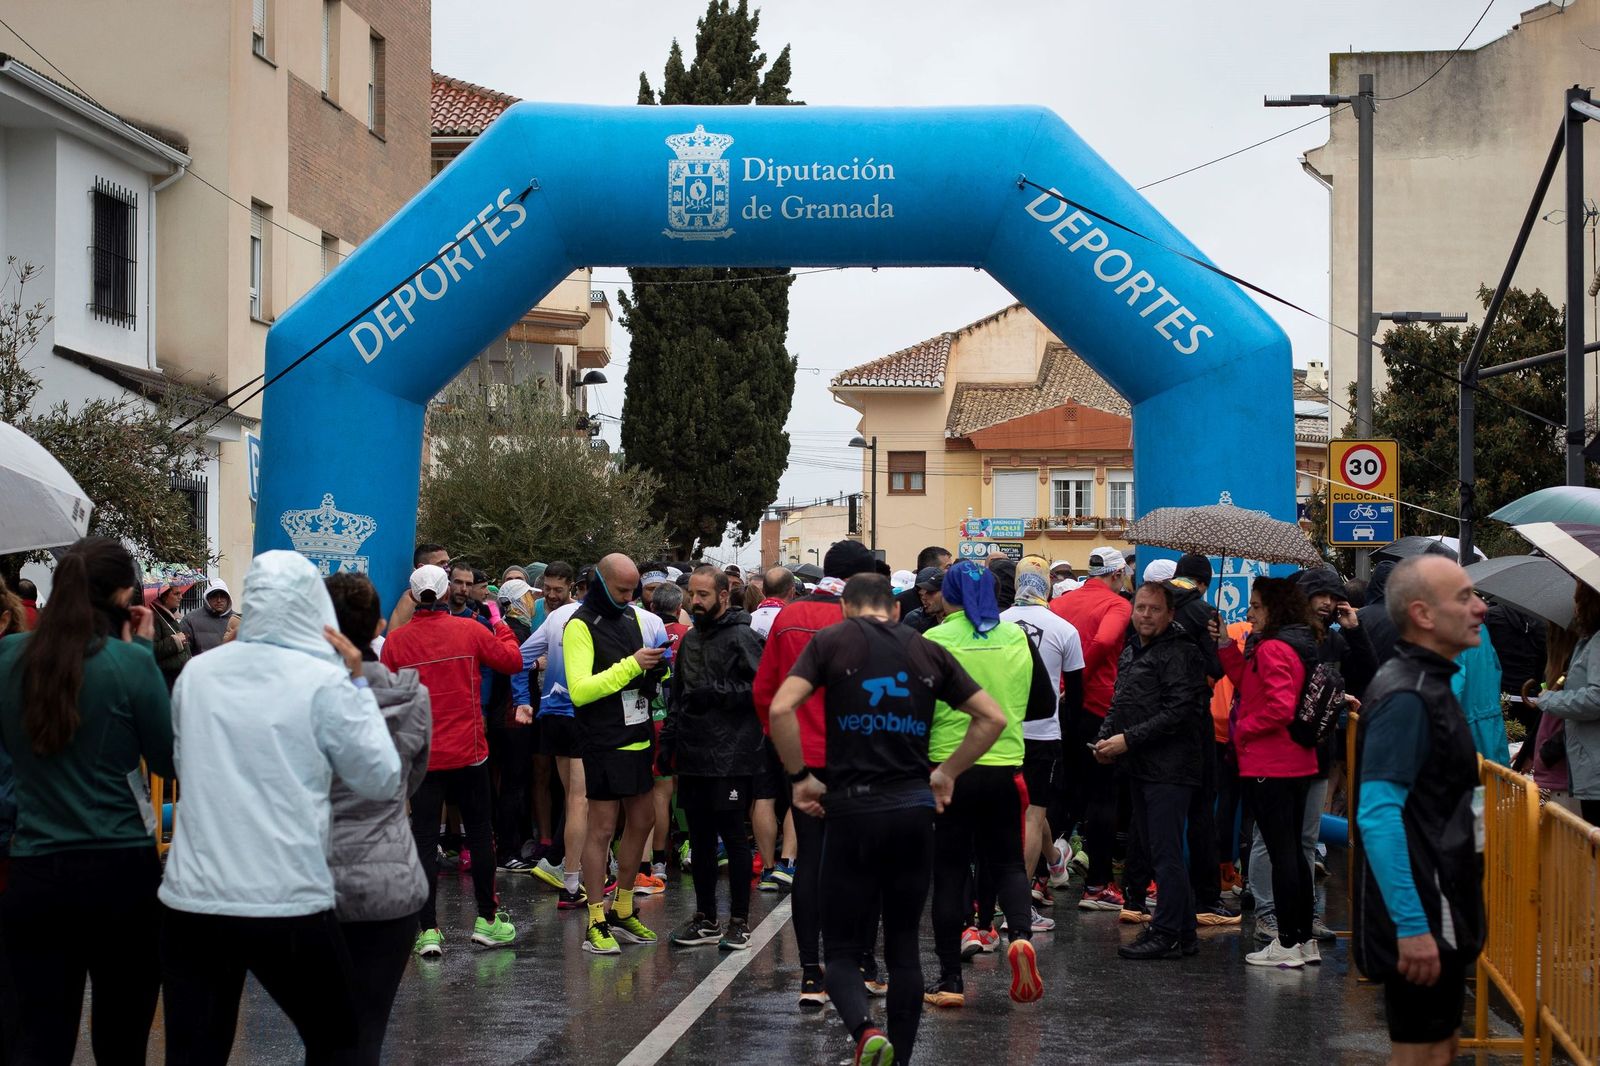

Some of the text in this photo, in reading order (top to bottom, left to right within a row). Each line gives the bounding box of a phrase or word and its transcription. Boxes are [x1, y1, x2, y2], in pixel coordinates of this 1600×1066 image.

[741, 156, 896, 187] Diputación
[741, 194, 895, 220] de Granada
[348, 188, 527, 365] DEPORTES
[1024, 187, 1215, 355] DEPORTES
[1349, 459, 1378, 476] 30
[1333, 492, 1395, 501] CICLOCALLE
[837, 712, 927, 736] vegabike
